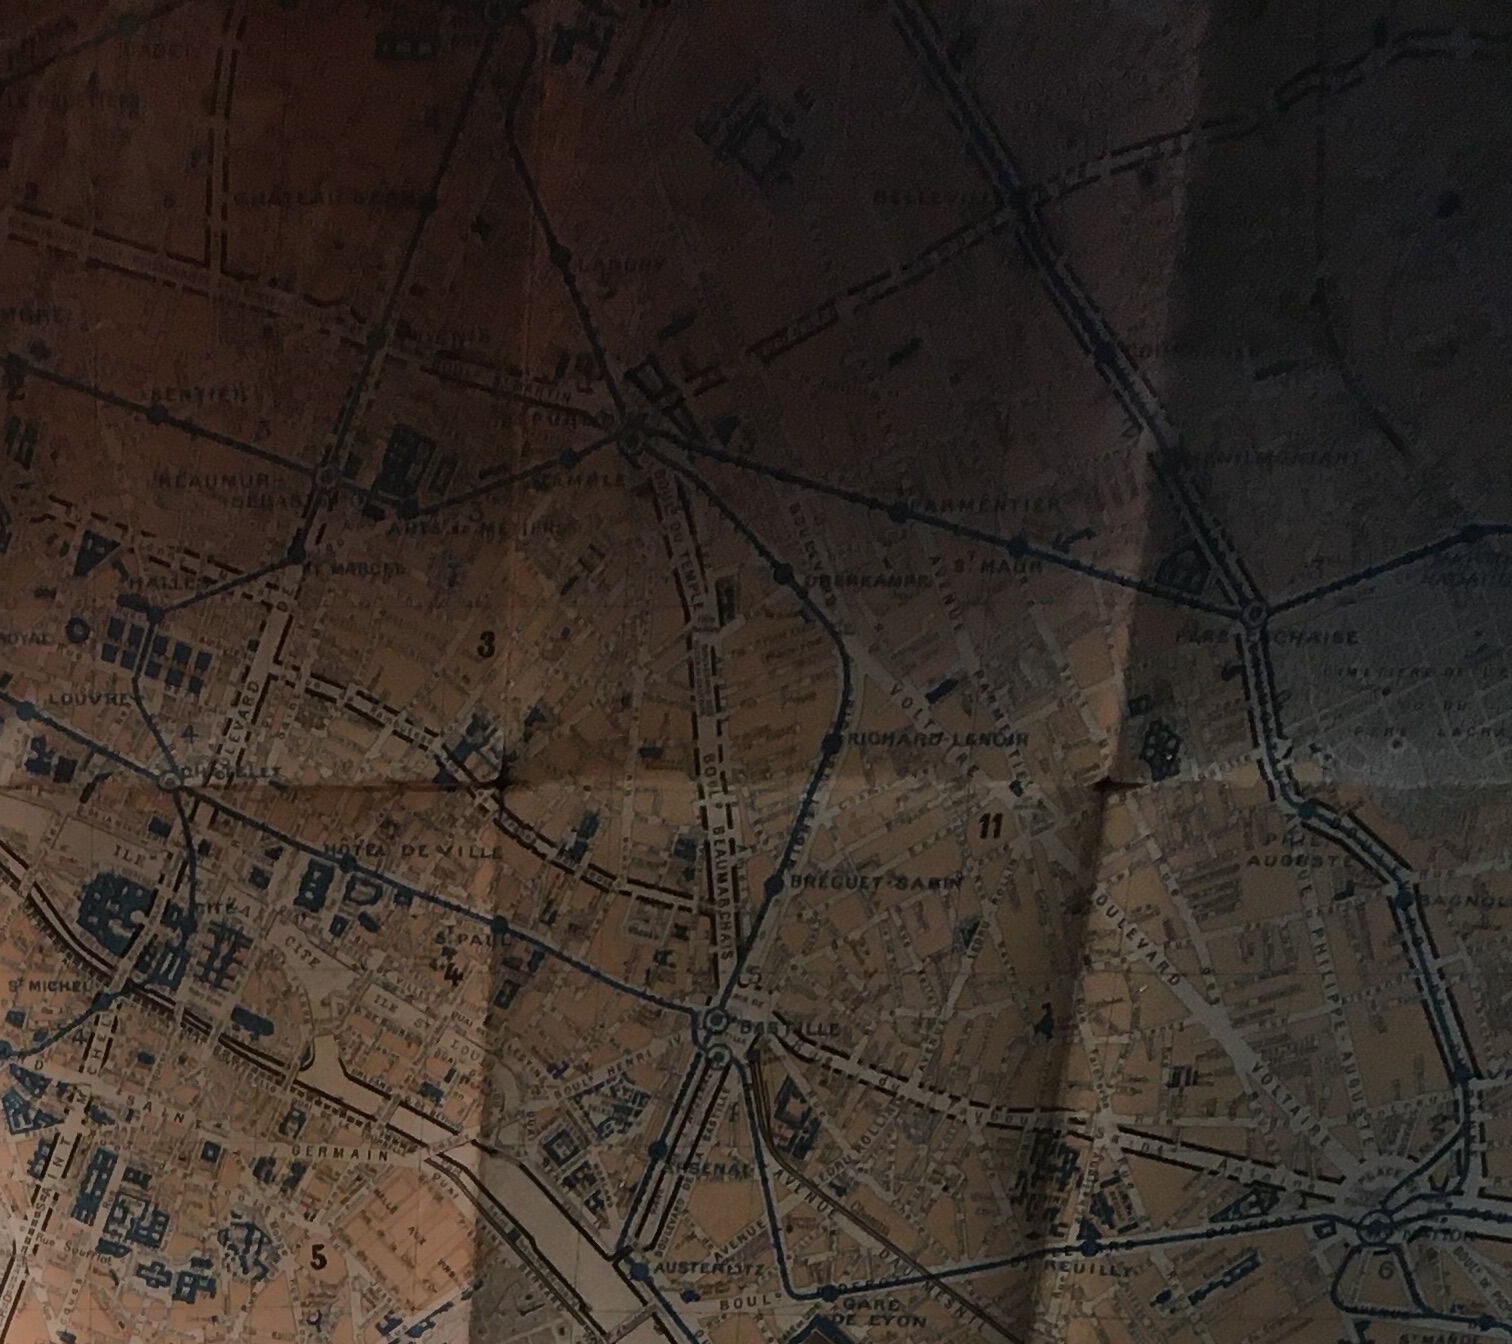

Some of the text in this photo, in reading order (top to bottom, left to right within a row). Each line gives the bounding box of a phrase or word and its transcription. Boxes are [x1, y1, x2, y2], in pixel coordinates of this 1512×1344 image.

[478, 630, 495, 659] 3
[978, 813, 1003, 839] 11
[291, 1146, 390, 1162] GERMAIN
[310, 1243, 329, 1272] 5
